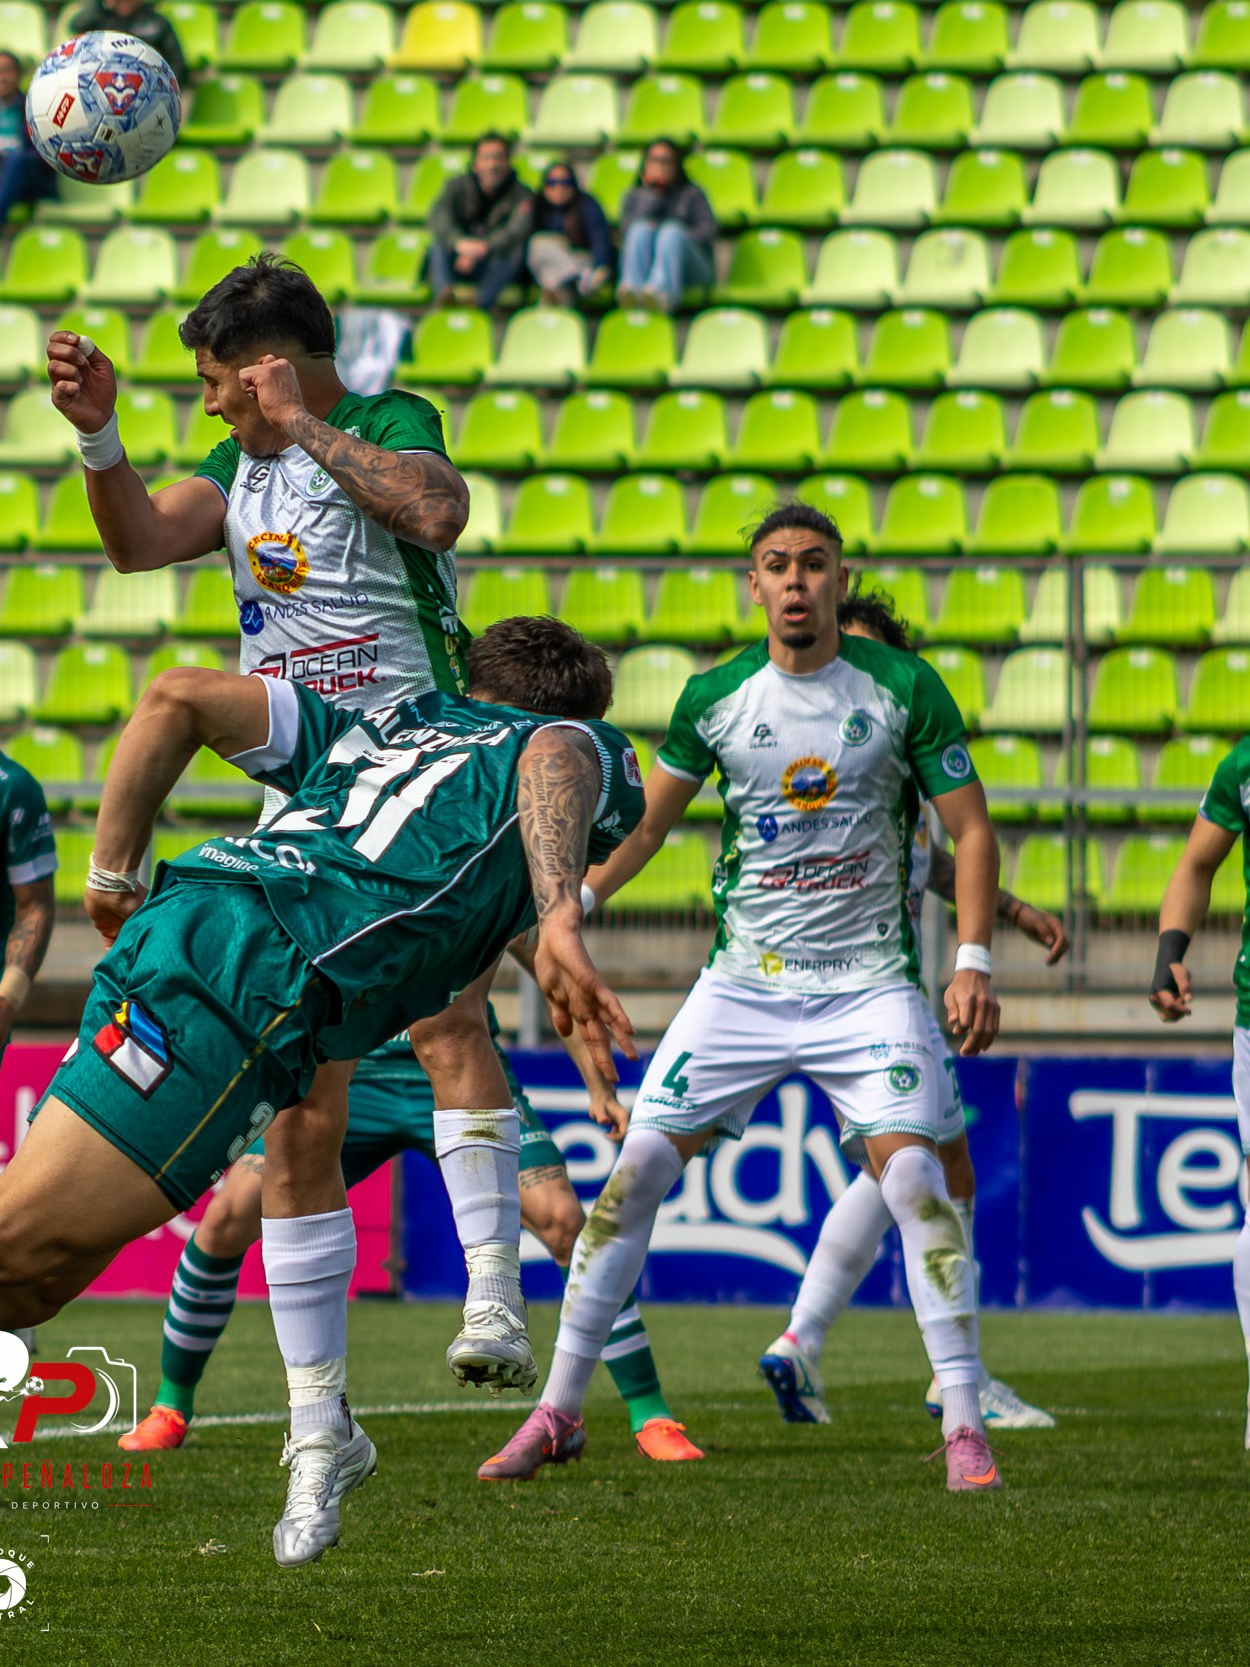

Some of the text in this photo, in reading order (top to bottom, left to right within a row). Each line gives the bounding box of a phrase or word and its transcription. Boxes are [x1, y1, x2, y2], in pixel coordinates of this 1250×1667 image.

[264, 592, 369, 621] ANDES SALUD
[291, 644, 379, 680] OCEAN
[267, 724, 472, 864] 31
[537, 804, 554, 836] beats
[781, 819, 829, 835] ANDES
[198, 843, 260, 872] imagine
[538, 839, 563, 876] talent
[785, 959, 853, 972] ENERPRY
[661, 1051, 693, 1098] 4
